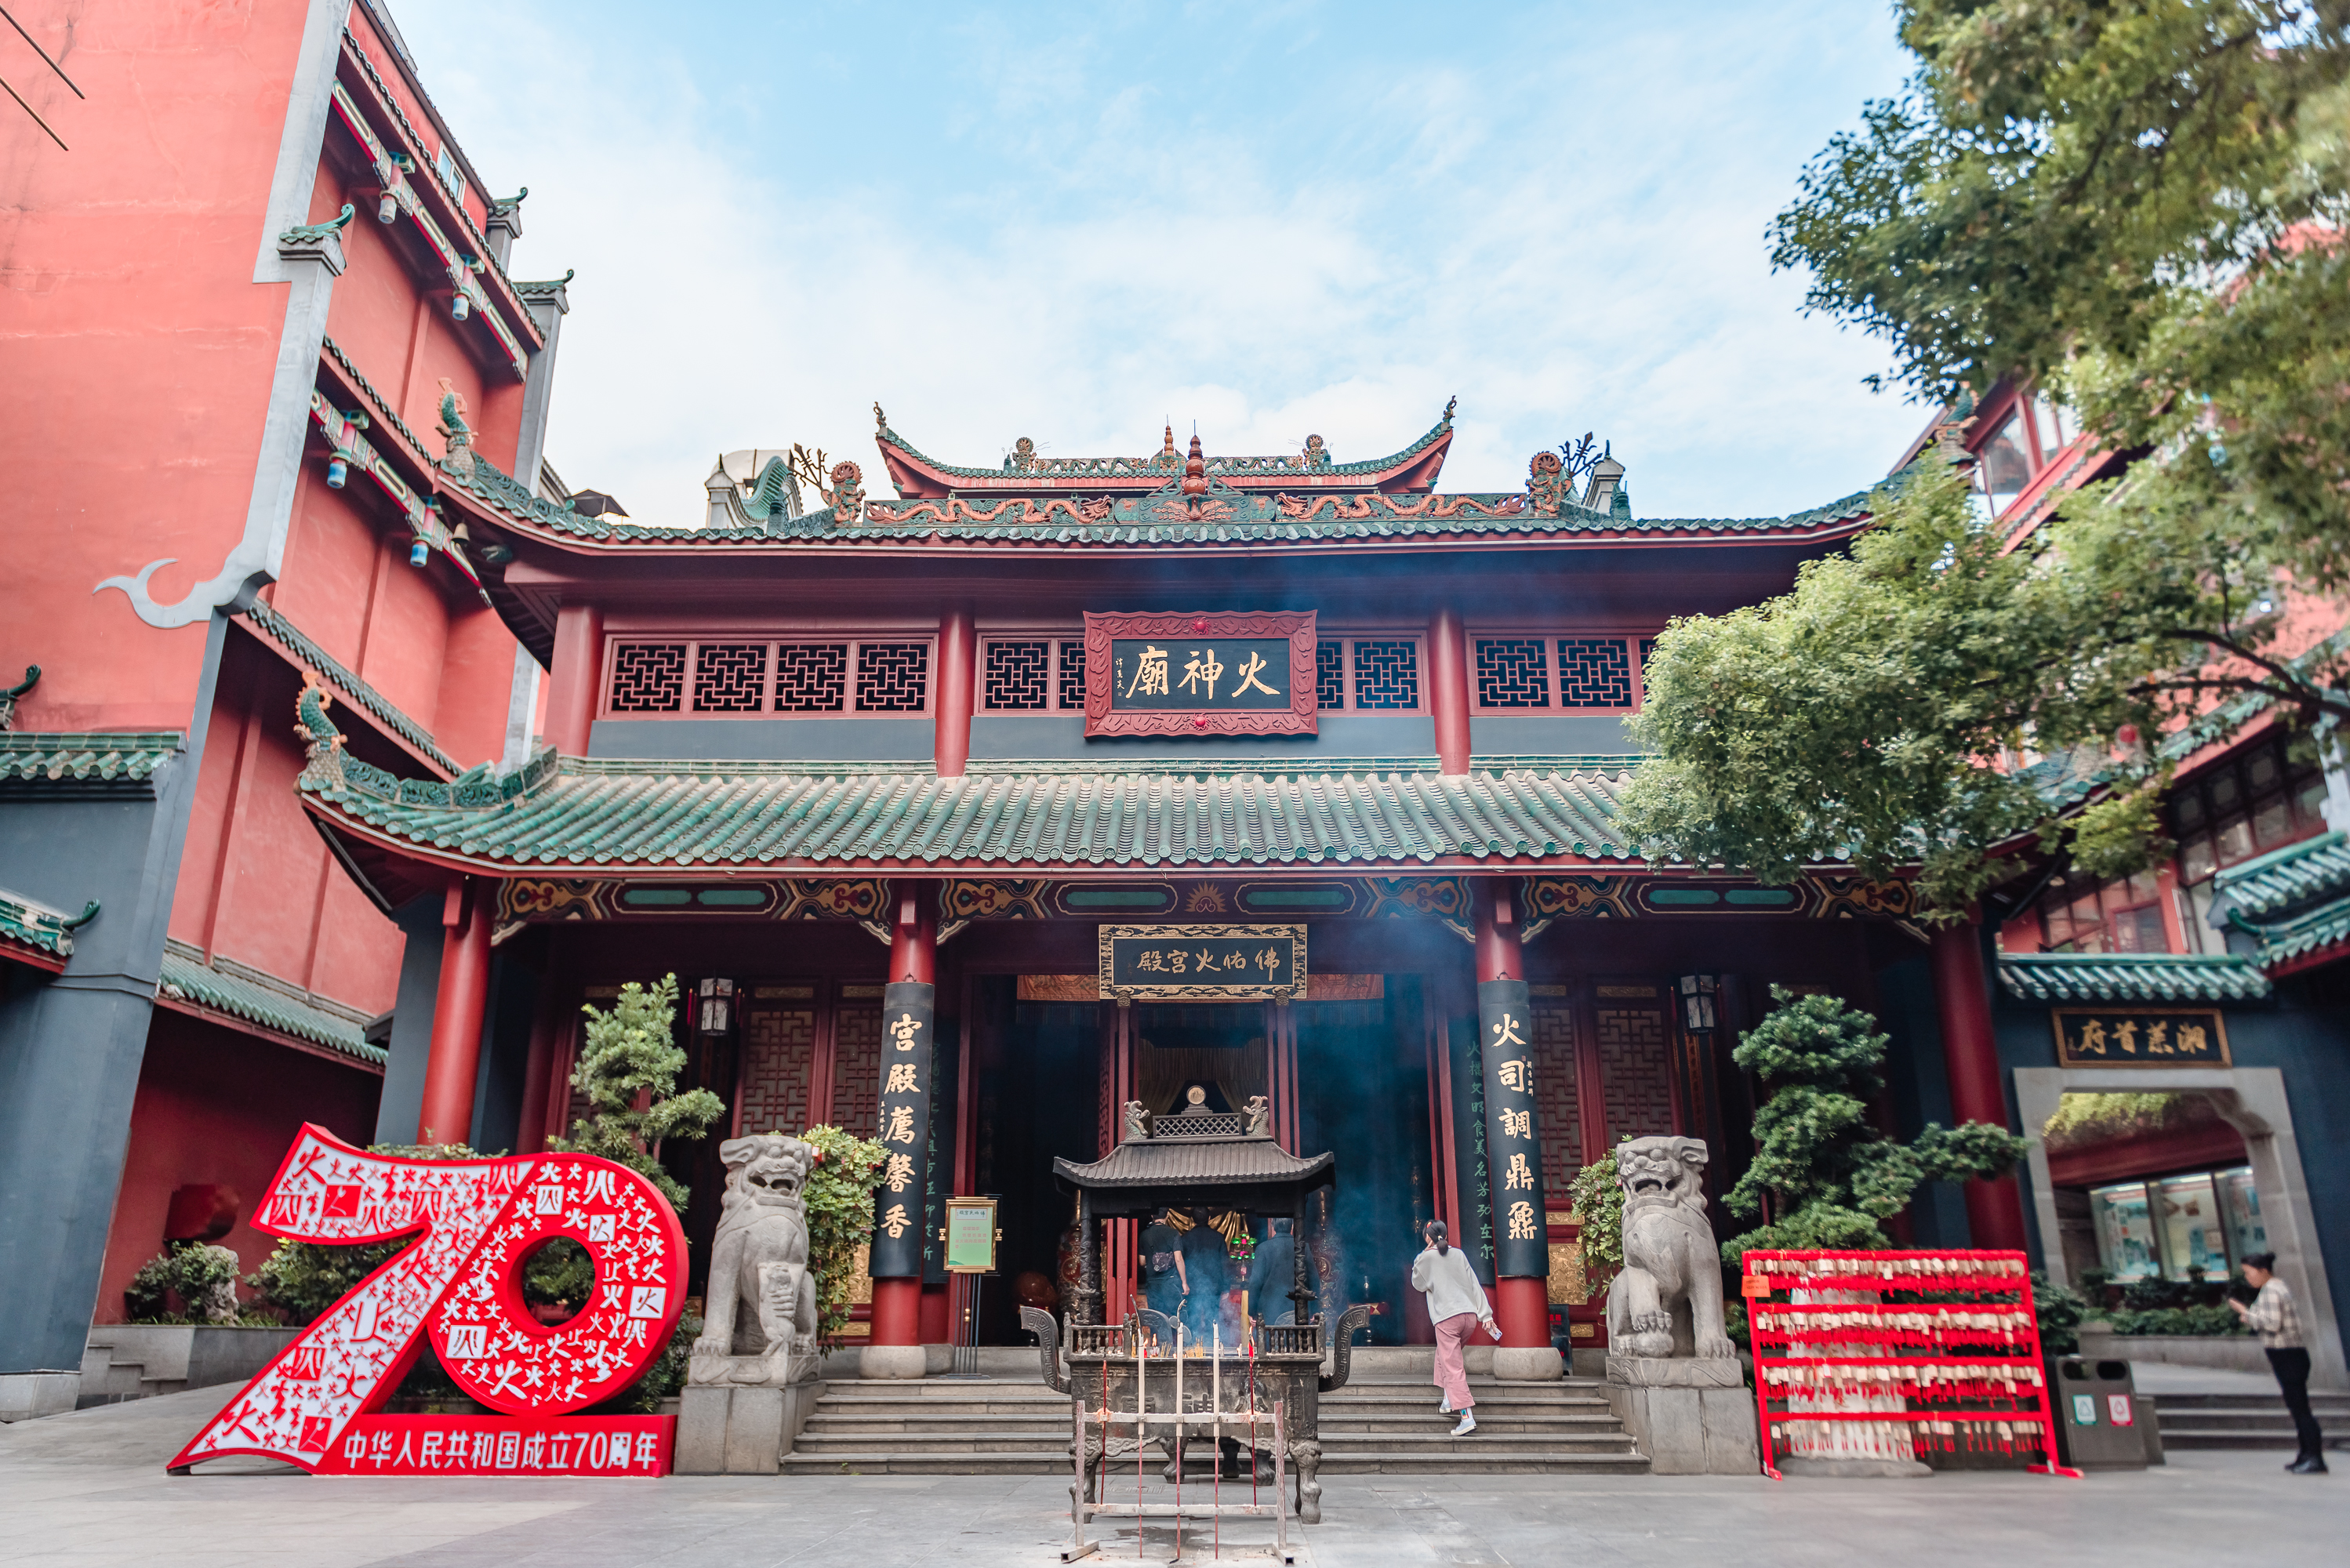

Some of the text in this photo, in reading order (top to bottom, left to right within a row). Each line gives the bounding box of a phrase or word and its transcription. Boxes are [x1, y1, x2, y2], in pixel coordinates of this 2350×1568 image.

[1125, 644, 1280, 700] 火神廟
[343, 1429, 659, 1471] 中华人民共和国成立70周年
